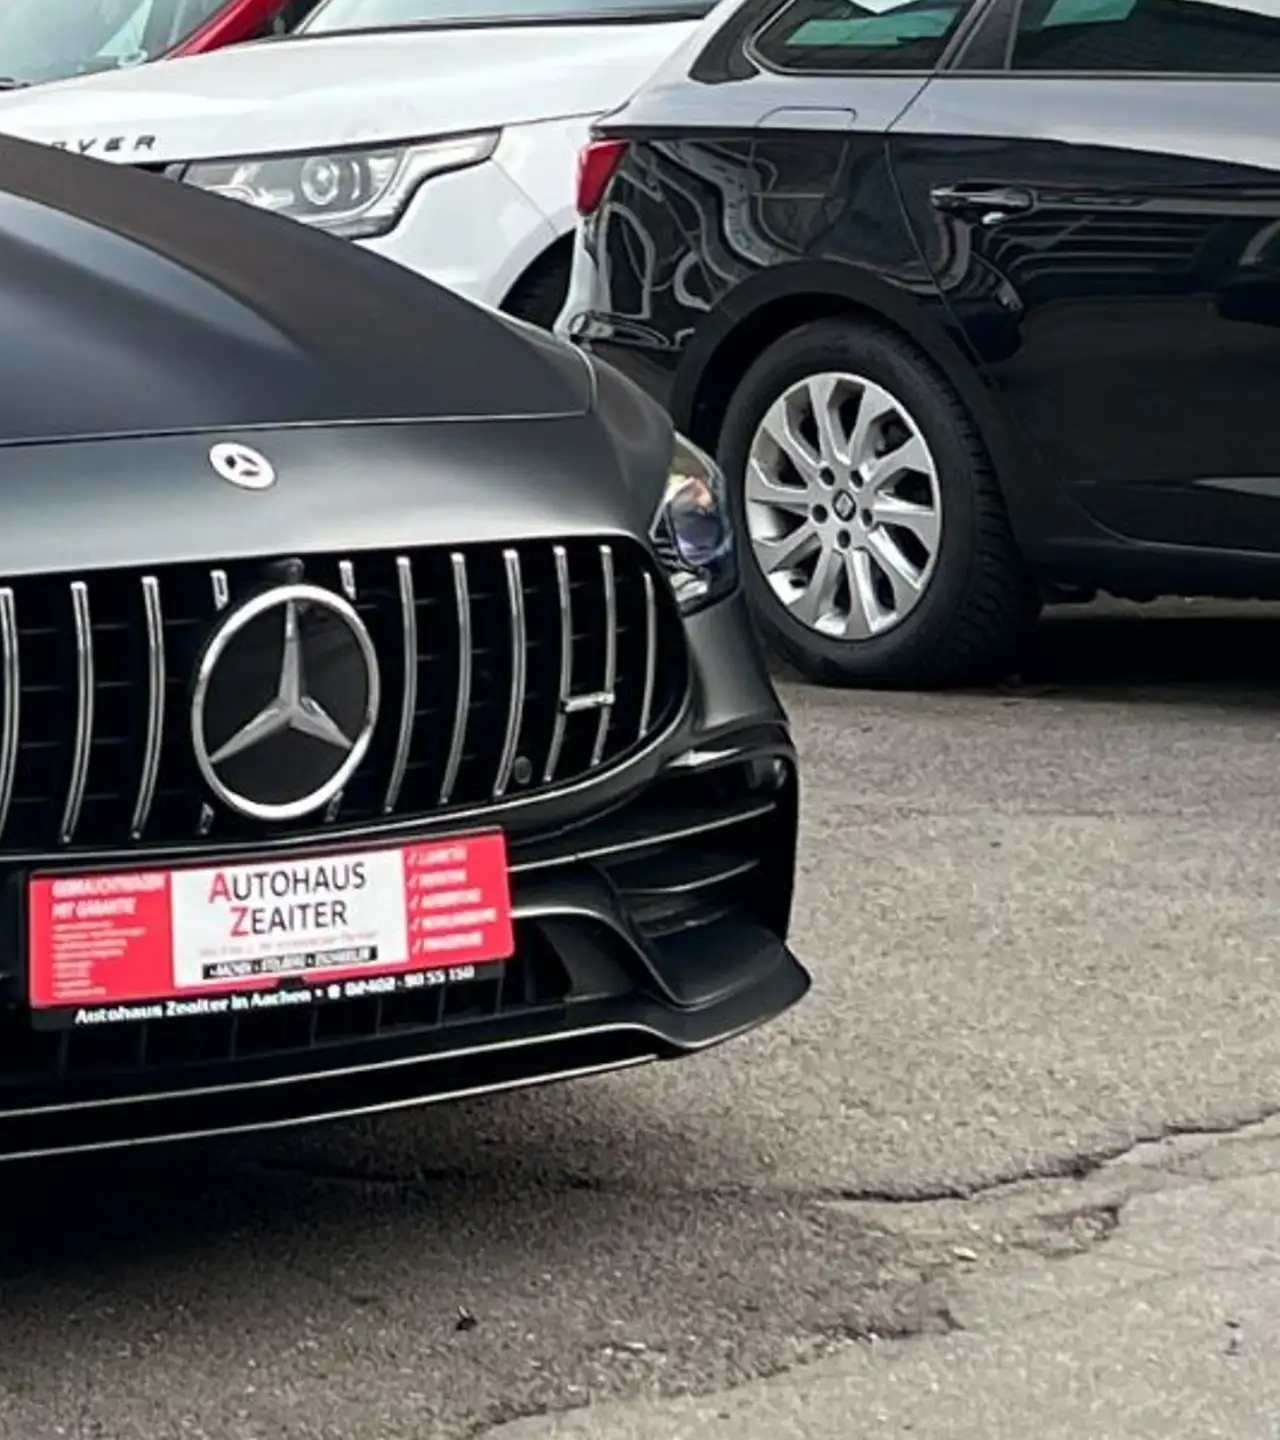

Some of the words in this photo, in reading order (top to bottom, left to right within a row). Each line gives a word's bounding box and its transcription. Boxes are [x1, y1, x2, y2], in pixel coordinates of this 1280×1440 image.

[208, 861, 367, 905] AUTOHAUS
[229, 899, 349, 938] ZEAITER
[74, 1004, 163, 1025] Autohaus
[250, 989, 312, 1008] Aachen
